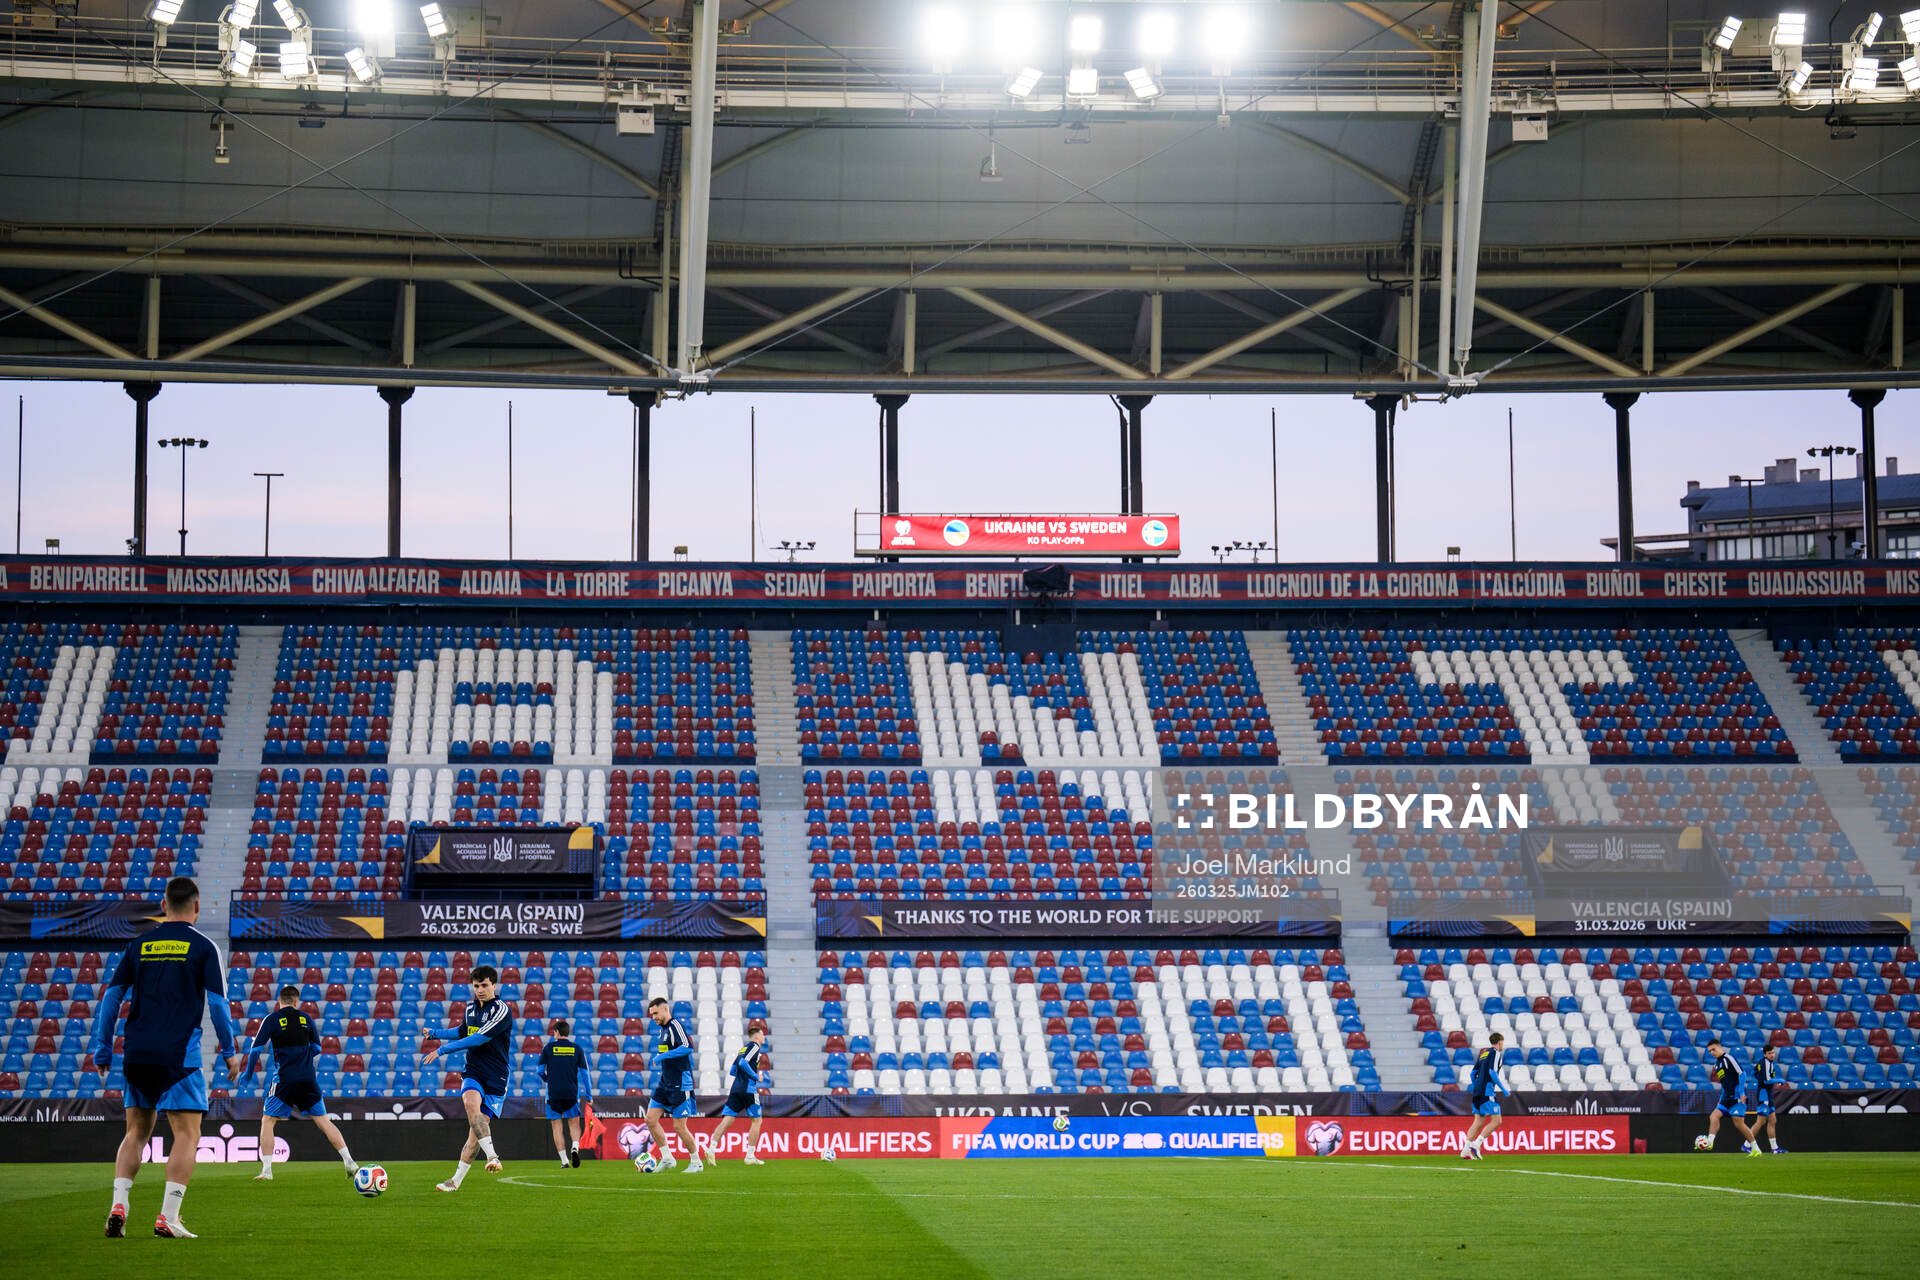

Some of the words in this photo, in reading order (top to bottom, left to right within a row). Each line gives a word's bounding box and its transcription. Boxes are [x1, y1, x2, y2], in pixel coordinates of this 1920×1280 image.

[985, 521, 1046, 534] UKRAINE
[1049, 521, 1067, 534] VS
[1070, 521, 1127, 534] SWEDEN
[1027, 536, 1040, 545] KO
[29, 565, 148, 592] BENIPARRELL
[166, 566, 291, 593] MASSANASSA
[312, 567, 366, 593] CHIVA
[368, 566, 440, 594] ALFAFAR
[459, 570, 522, 596] ALDAIA
[546, 571, 567, 597] LA
[573, 571, 629, 597] TORRE
[658, 571, 733, 597] PICANYA
[764, 569, 826, 597] SEDAVÍ
[852, 571, 936, 597] PAIPORTA
[1100, 573, 1145, 599] UTIEL
[1169, 573, 1221, 598] ALBAL
[1247, 573, 1324, 598] LLOCNOU
[1330, 573, 1352, 598] DE
[1360, 573, 1379, 598] LA
[1386, 572, 1459, 598] CORONA
[1586, 568, 1644, 597] BUÑOL
[1663, 570, 1728, 597] CHESTE
[1748, 570, 1866, 595] GUADASSUAR
[420, 905, 513, 920] VALENCIA
[517, 903, 585, 922] (SPAIN)
[895, 910, 966, 924] THANKS
[969, 910, 993, 924] TO
[997, 910, 1032, 924] THE
[1036, 910, 1101, 924] WORLD
[1106, 909, 1142, 924] FOR
[1145, 909, 1179, 924] THE
[1184, 909, 1263, 924] SUPPORT
[1571, 901, 1662, 917] VALENCIA
[1666, 899, 1733, 918] (SPAIN)
[420, 923, 496, 934] 26.03.2026
[507, 923, 538, 934] UKR
[551, 923, 583, 934] SWE
[1575, 919, 1646, 931] 31.03.2026
[1656, 919, 1687, 931] UKR
[798, 1131, 932, 1153] QUALIFIERS
[952, 1133, 996, 1150] FIFA
[1000, 1133, 1075, 1150] WORLD
[1078, 1133, 1120, 1150] CUP
[1169, 1133, 1284, 1150] QUALIFIERS
[1483, 1129, 1616, 1151] QUALIFIERS
